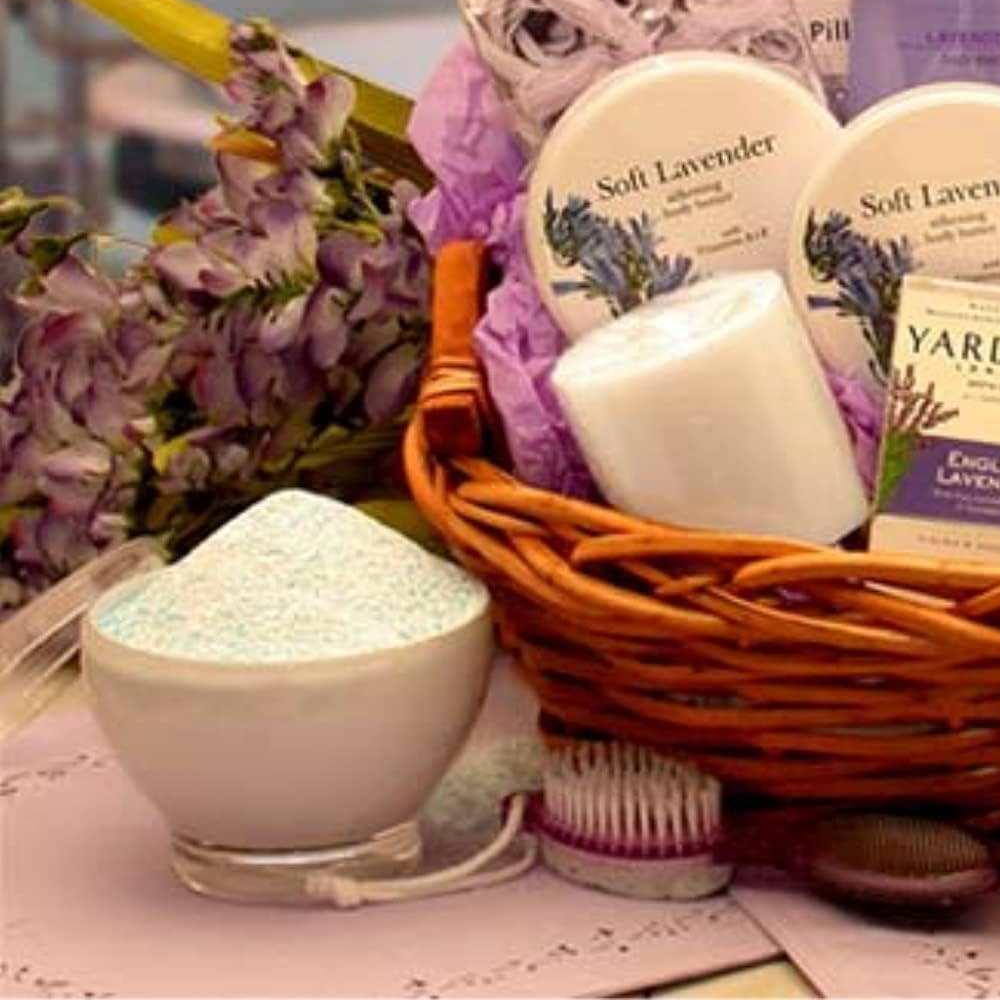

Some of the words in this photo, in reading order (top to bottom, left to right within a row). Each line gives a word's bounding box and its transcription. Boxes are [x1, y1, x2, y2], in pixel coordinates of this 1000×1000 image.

[810, 18, 850, 42] Pill
[594, 164, 650, 199] Soft
[653, 133, 777, 184] Lavender
[859, 186, 912, 218] Soft
